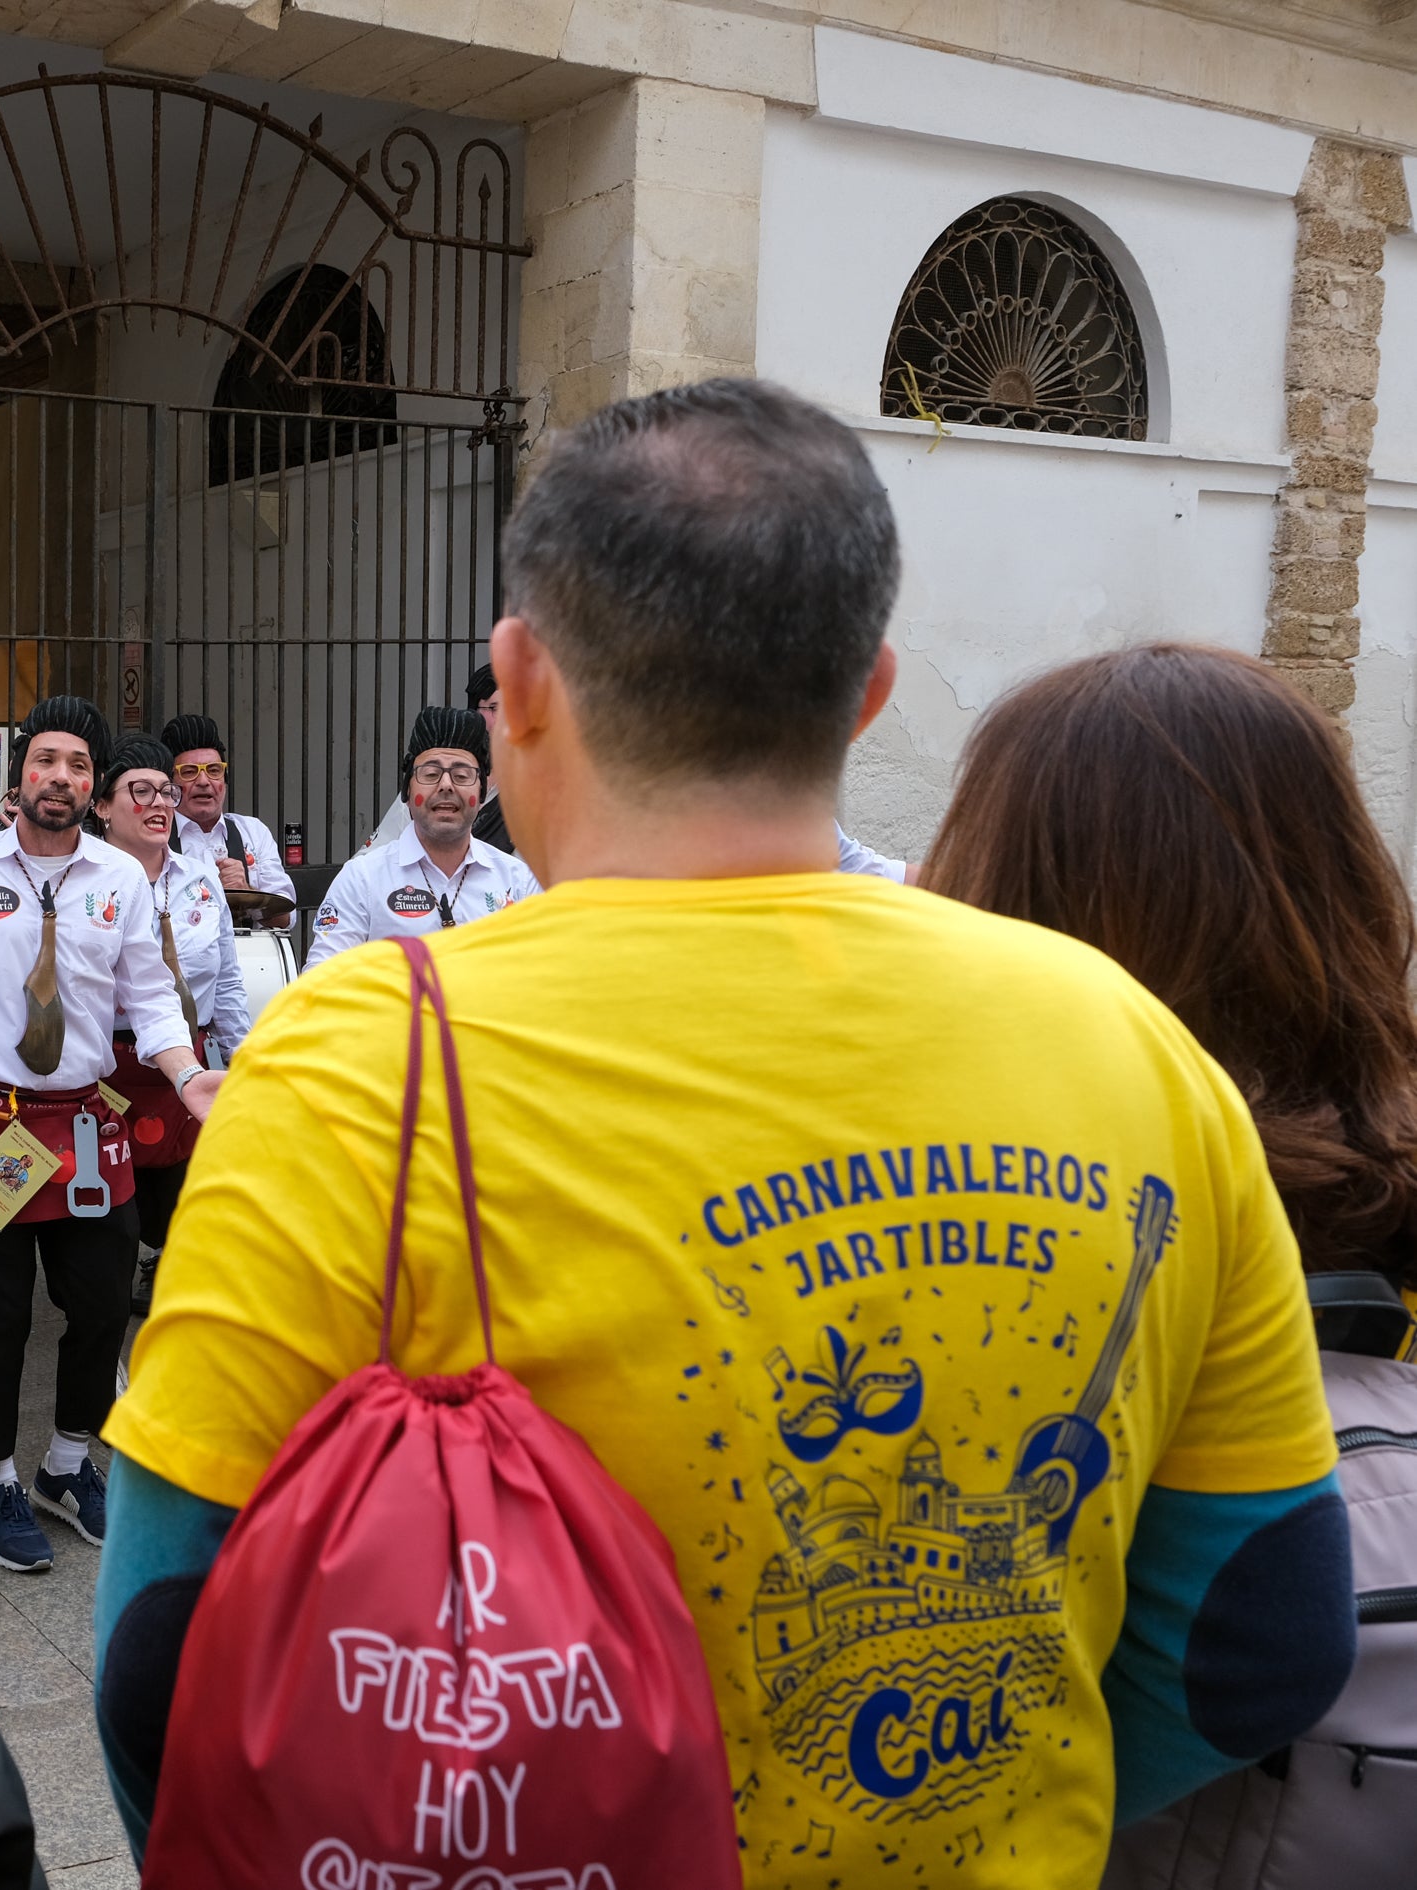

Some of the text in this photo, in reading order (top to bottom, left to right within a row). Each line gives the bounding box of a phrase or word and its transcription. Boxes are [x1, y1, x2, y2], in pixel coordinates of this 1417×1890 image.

[394, 901, 431, 911] Almería
[395, 894, 427, 902] Estrella
[702, 1143, 1109, 1247] CARNAVALEROS
[785, 1220, 1058, 1298] JARTIBLES
[329, 1628, 622, 1750] FIESTA
[414, 1760, 526, 1860] HOY
